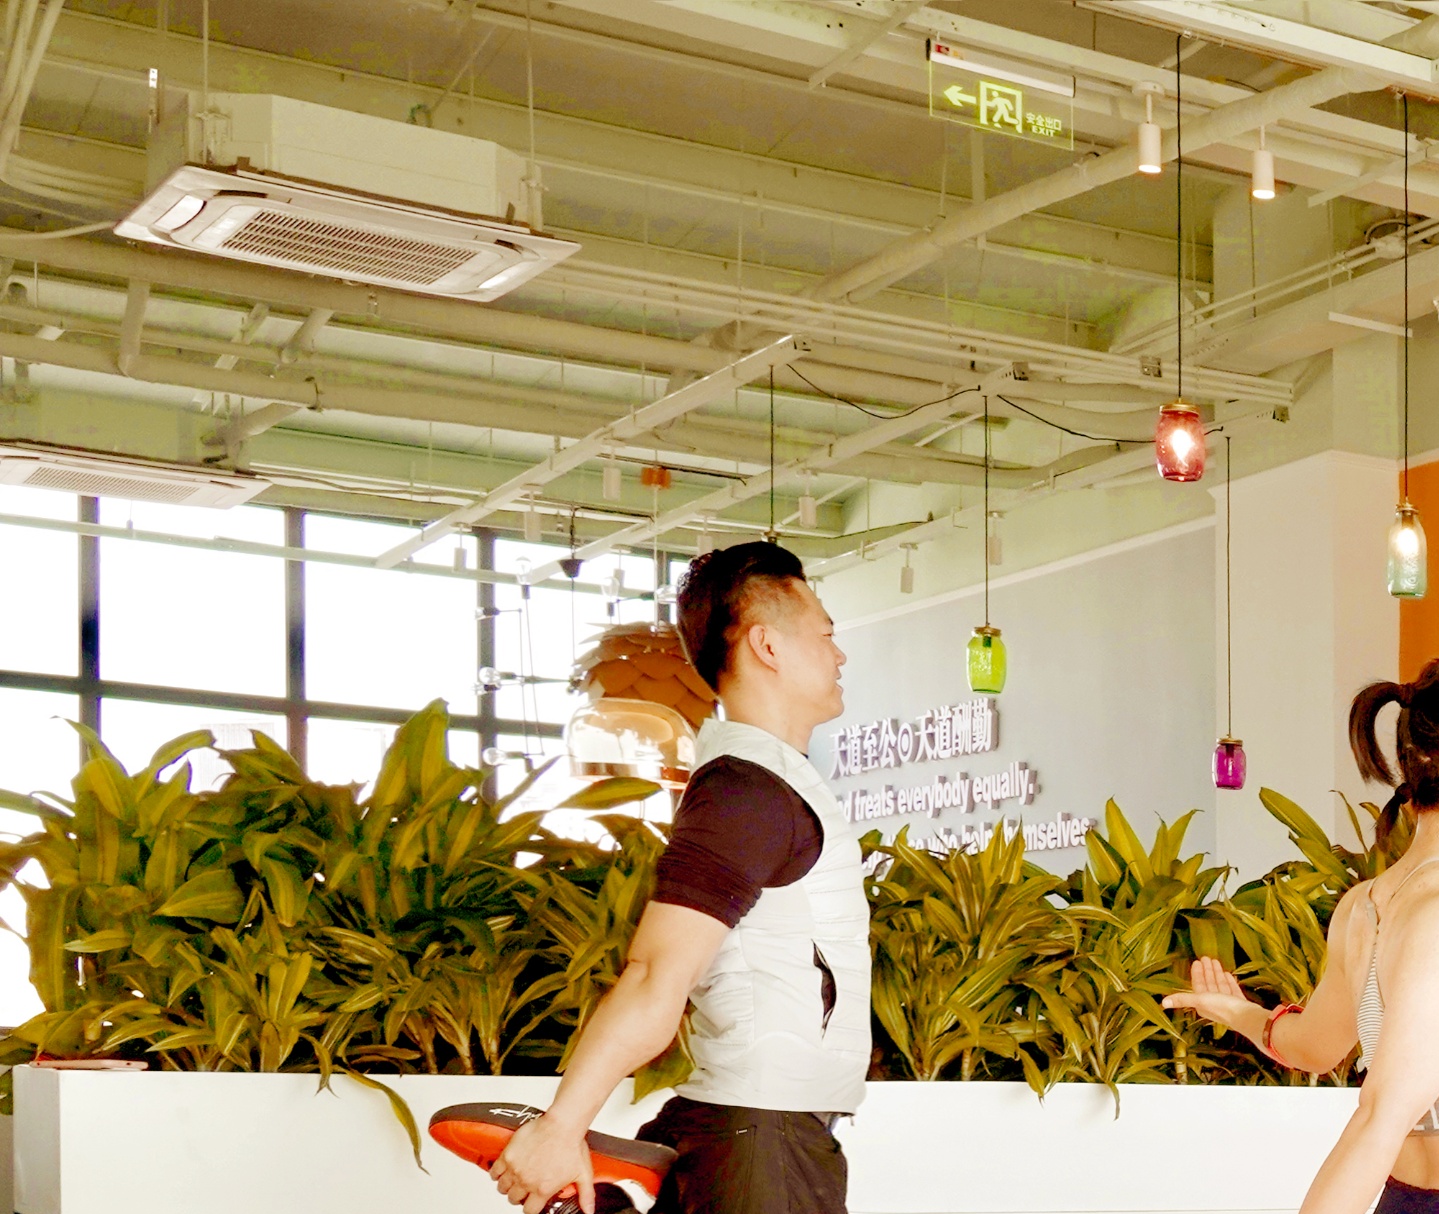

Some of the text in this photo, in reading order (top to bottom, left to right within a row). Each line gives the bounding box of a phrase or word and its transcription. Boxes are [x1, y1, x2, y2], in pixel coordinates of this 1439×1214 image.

[1026, 112, 1062, 131] 安全出口
[1032, 126, 1055, 137] EXIT
[855, 785, 893, 821] treats
[897, 771, 969, 818] everybody
